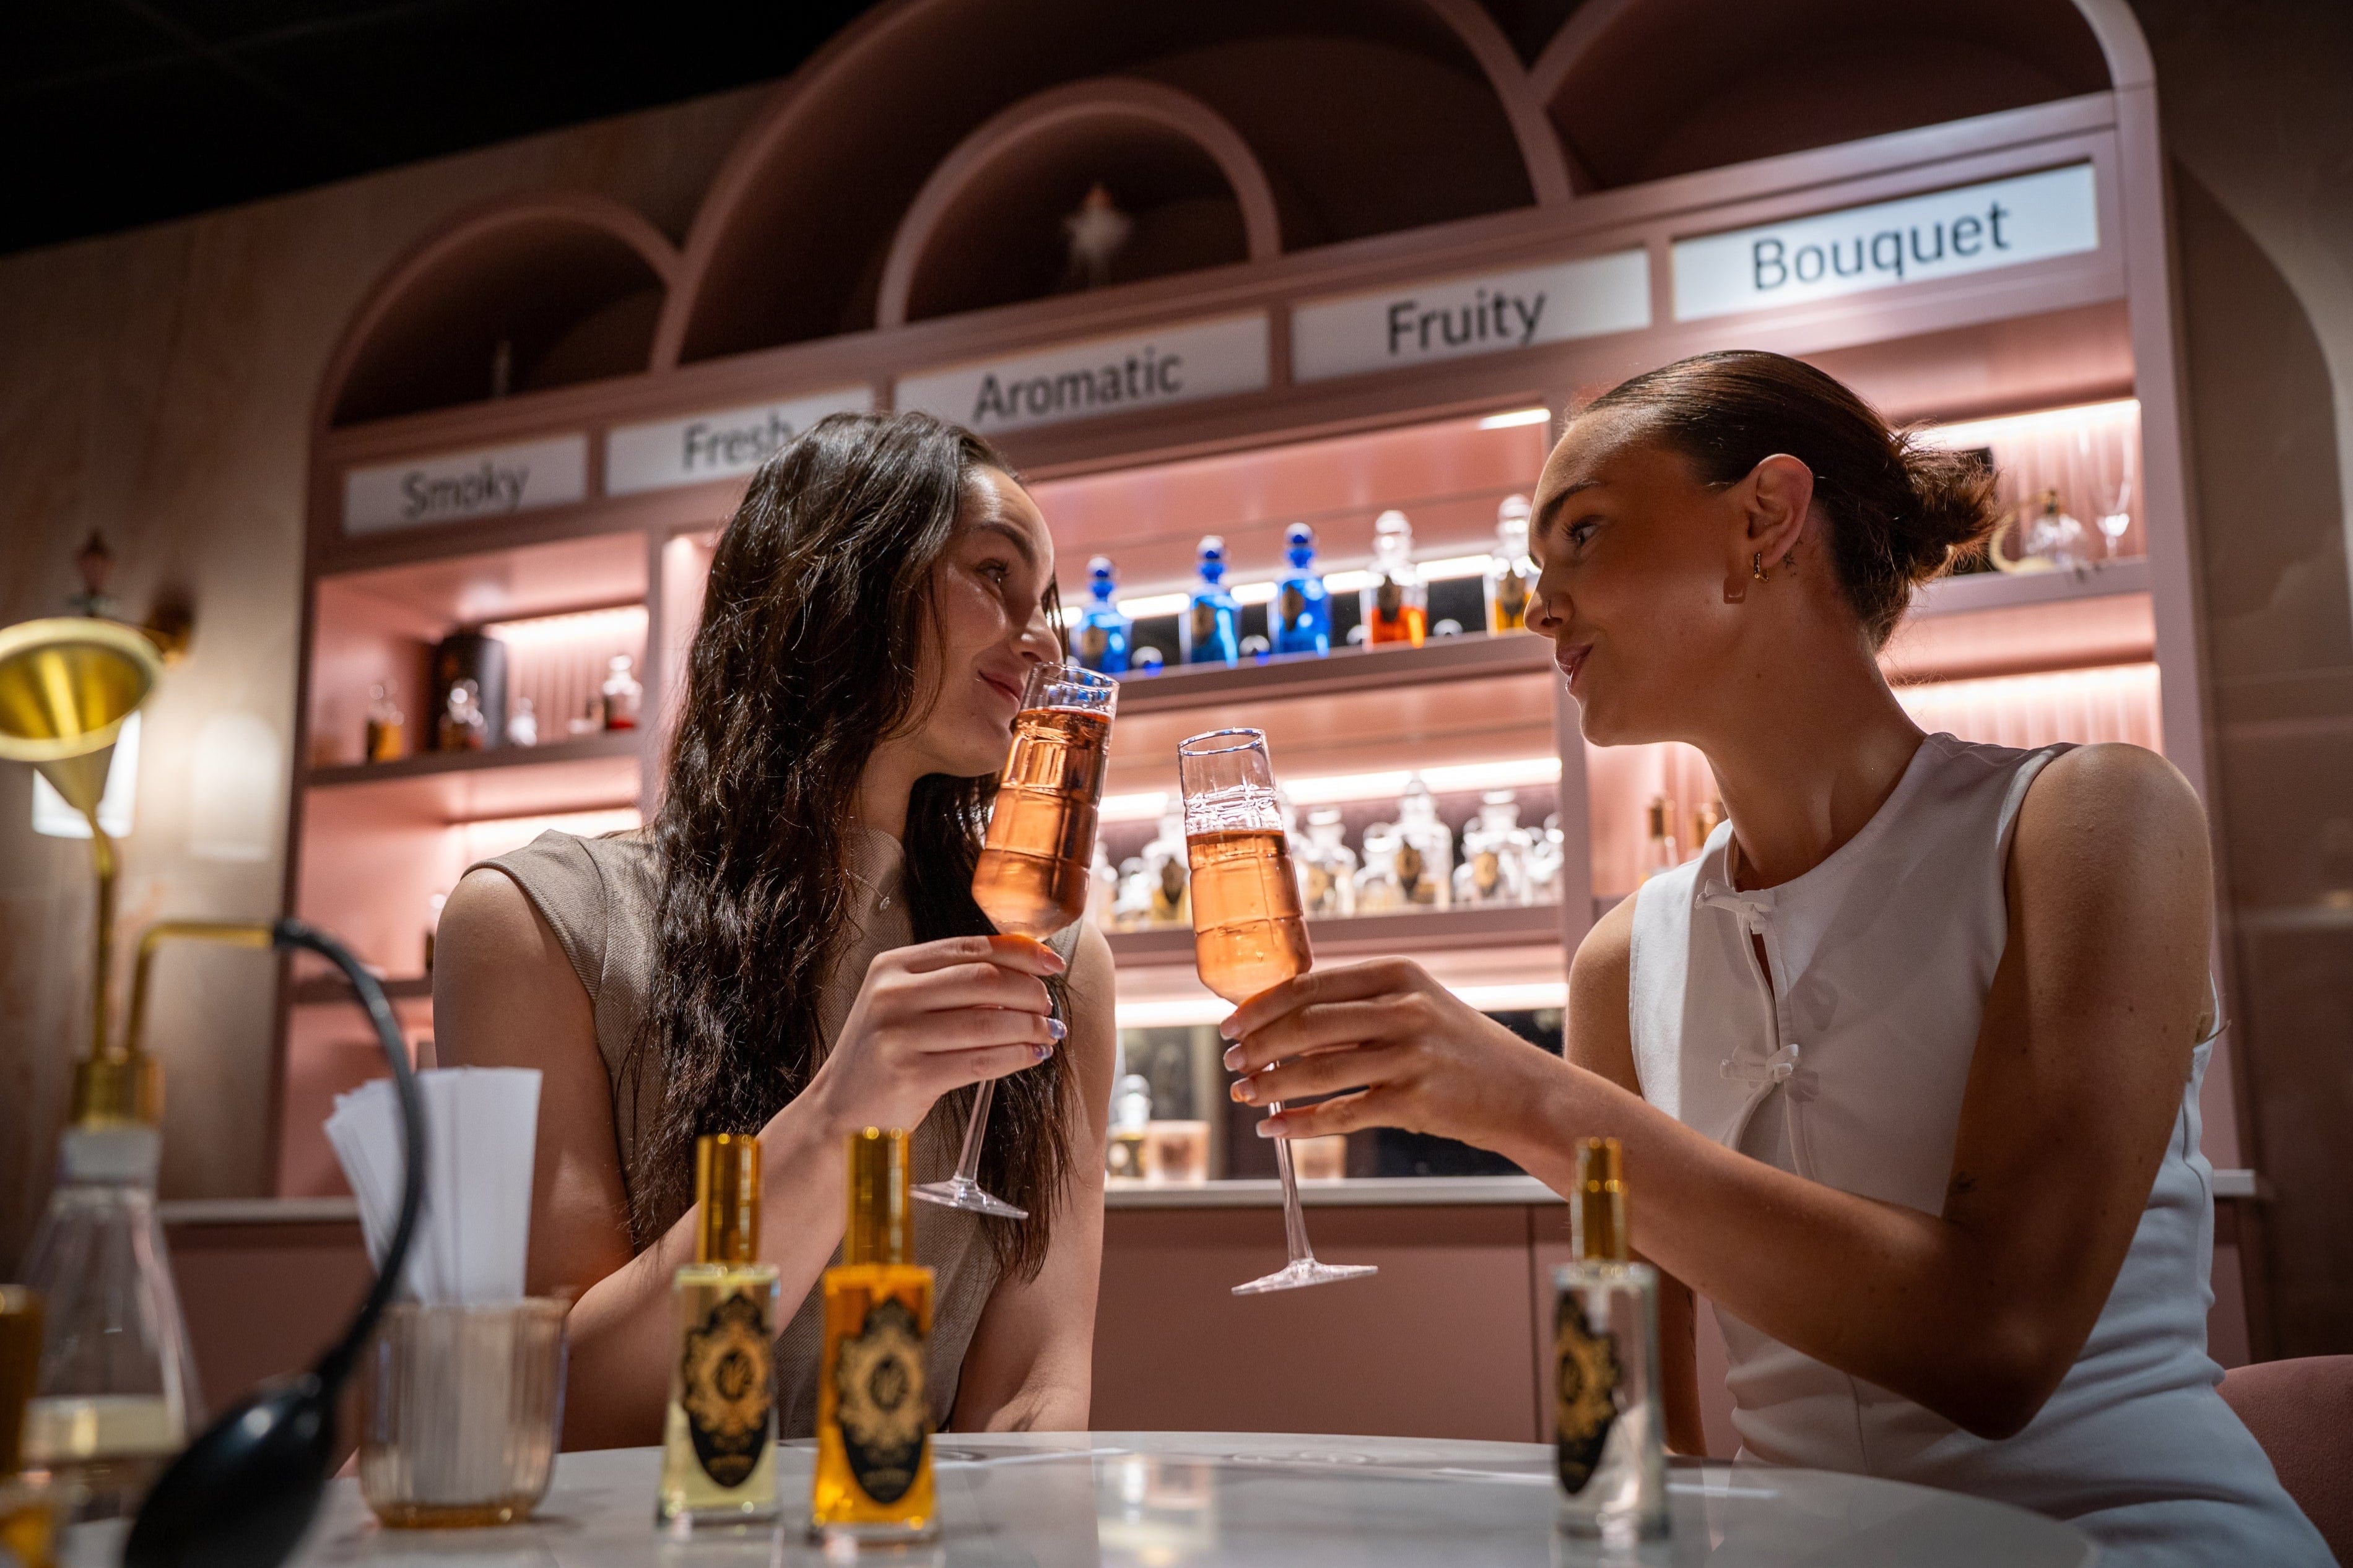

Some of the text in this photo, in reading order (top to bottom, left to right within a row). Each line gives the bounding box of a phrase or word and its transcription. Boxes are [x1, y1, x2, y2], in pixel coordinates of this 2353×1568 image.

[1753, 201, 2009, 290] Bouquet
[1388, 288, 1546, 356] Fruity
[972, 346, 1183, 423] Aromatic
[401, 459, 531, 520] Smoky
